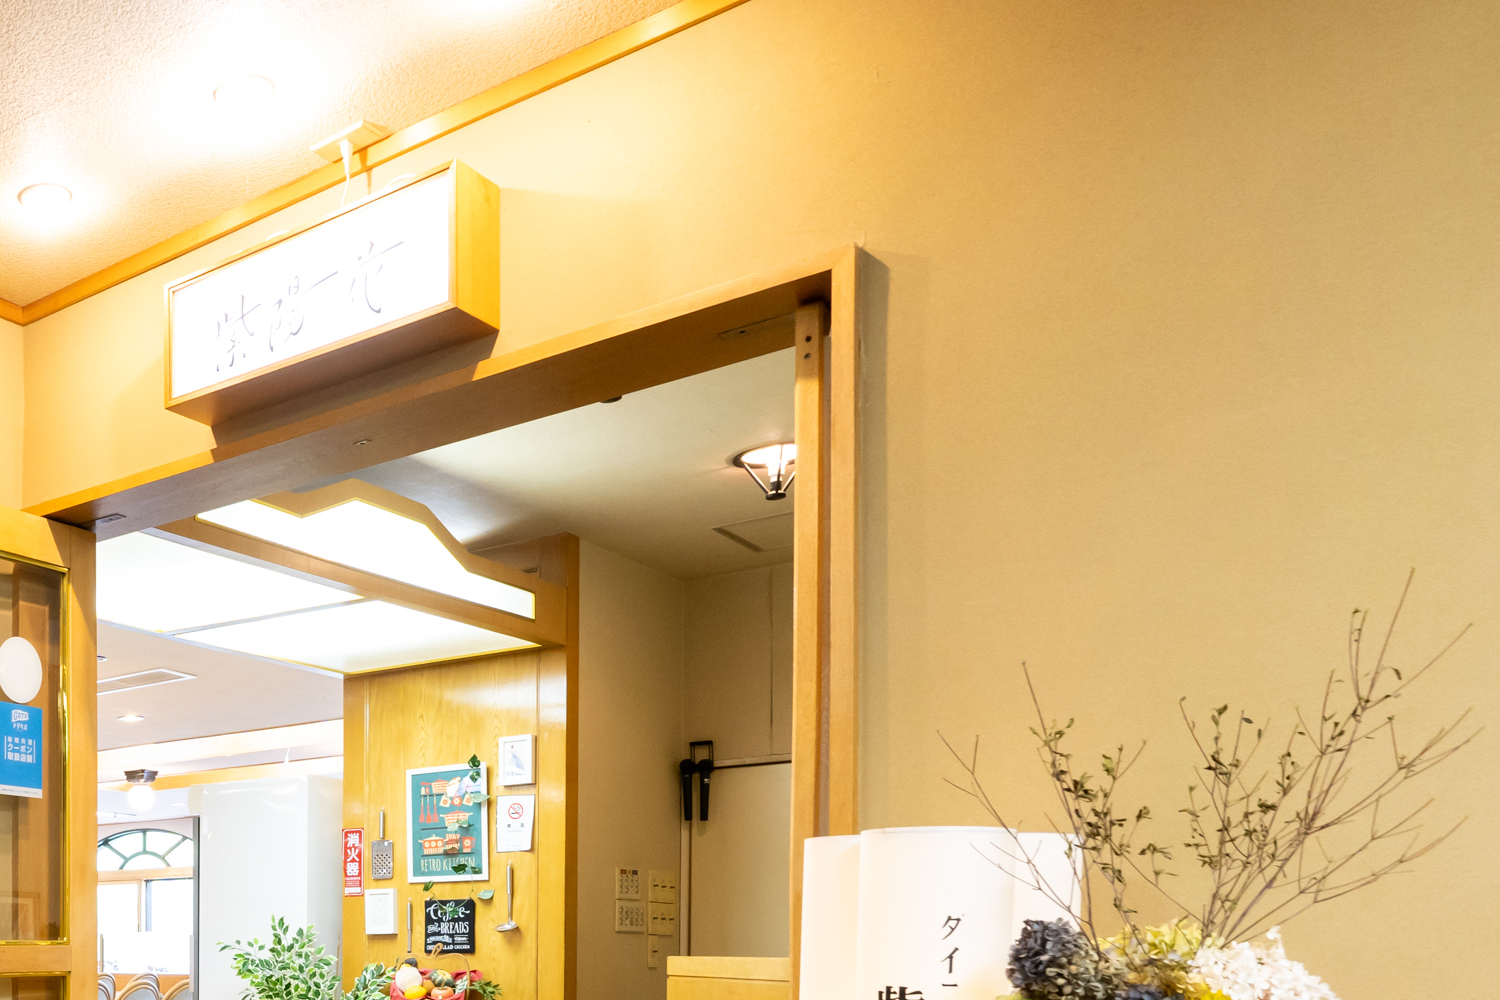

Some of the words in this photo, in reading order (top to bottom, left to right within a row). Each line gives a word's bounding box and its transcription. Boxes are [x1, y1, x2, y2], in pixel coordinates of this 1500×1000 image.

[7, 743, 32, 753] クーポン
[346, 832, 360, 876] 消火器
[420, 858, 442, 872] RETRO
[440, 921, 469, 934] BREADS
